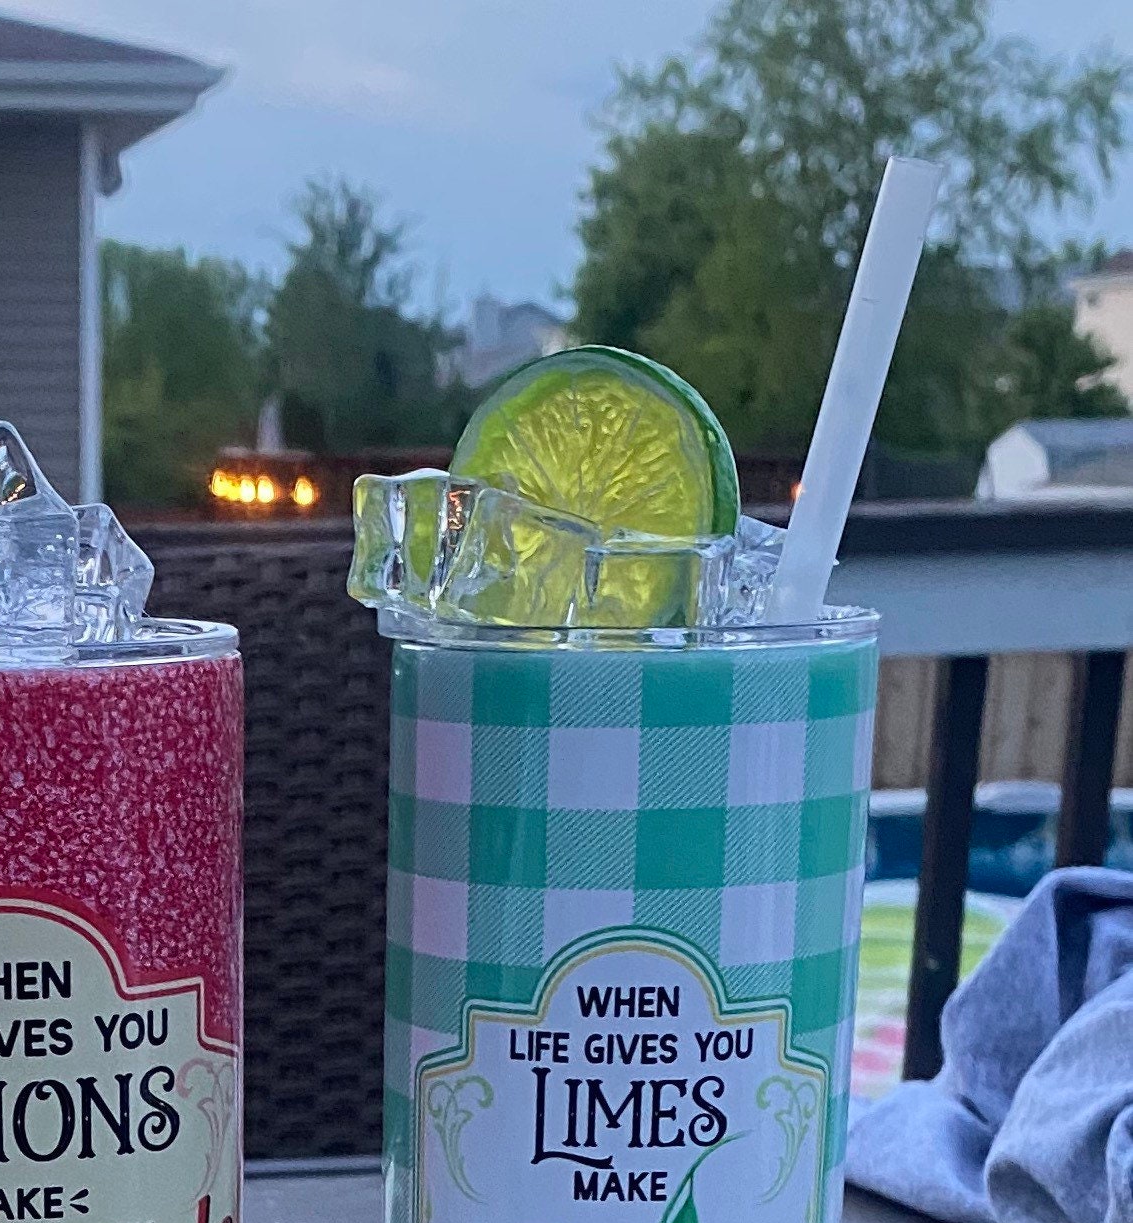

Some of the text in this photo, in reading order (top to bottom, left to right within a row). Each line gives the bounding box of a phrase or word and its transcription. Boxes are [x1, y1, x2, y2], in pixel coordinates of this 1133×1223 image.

[577, 986, 680, 1019] WHEN
[94, 1008, 168, 1052] YOU
[509, 1028, 754, 1066] LIFE GIVES YOU
[530, 1066, 728, 1170] LIMES
[573, 1170, 668, 1202] MAKE
